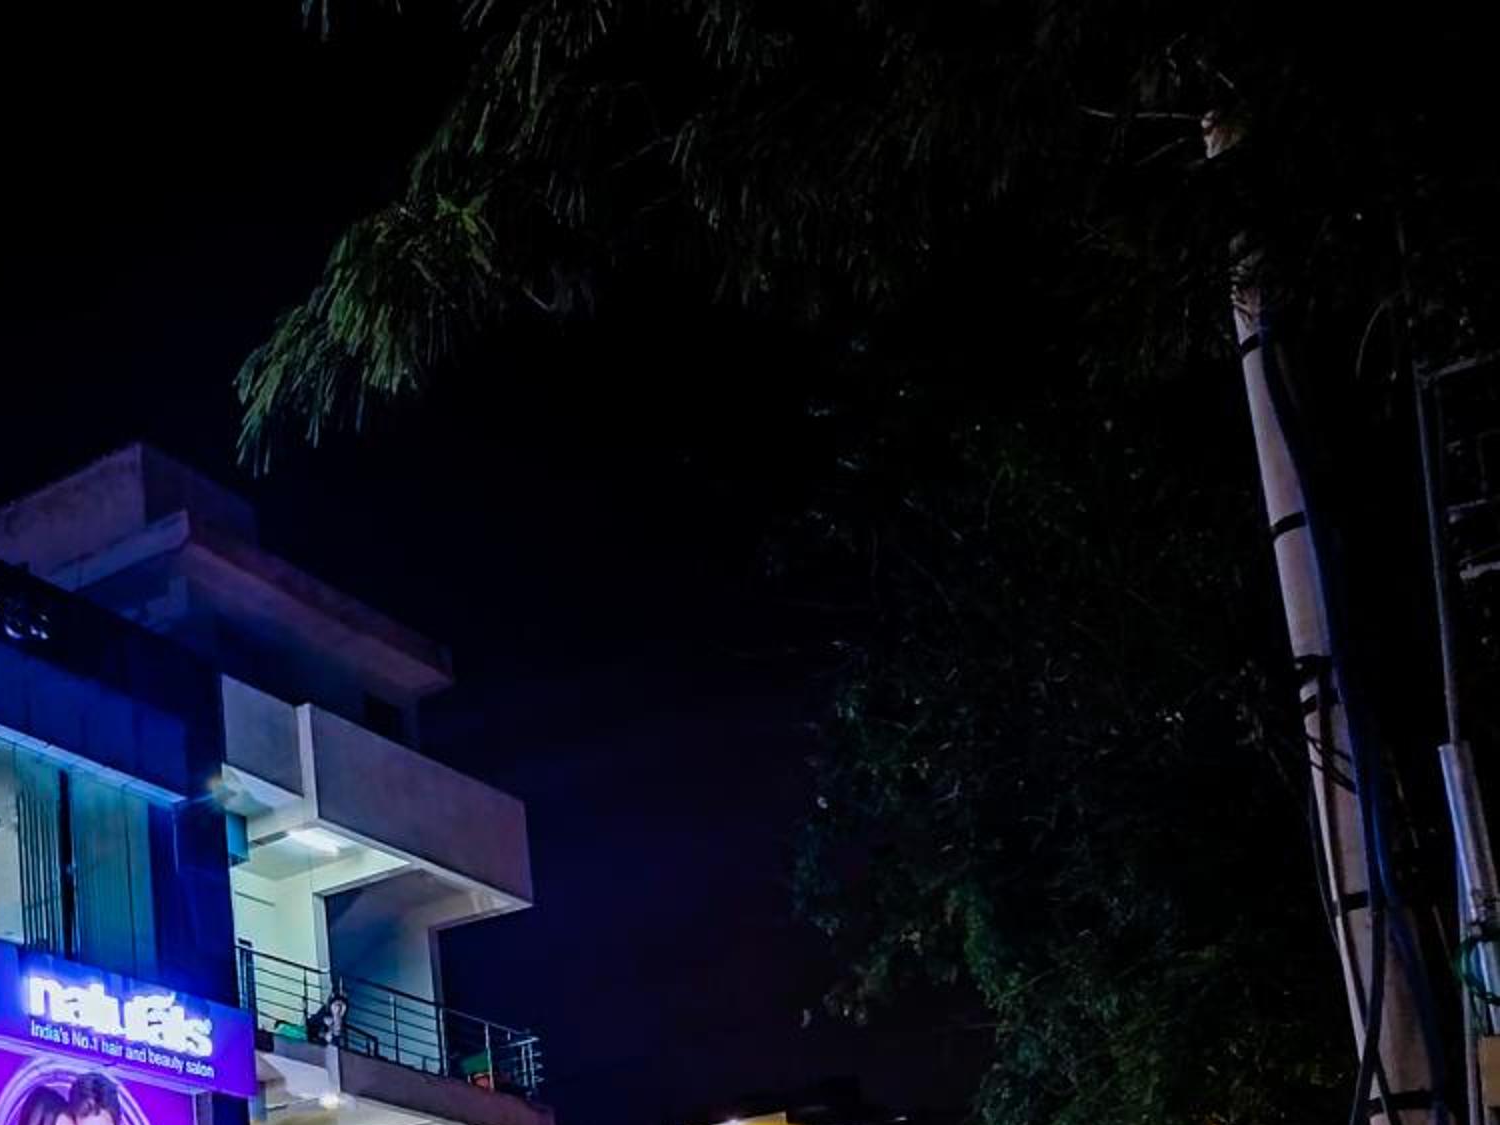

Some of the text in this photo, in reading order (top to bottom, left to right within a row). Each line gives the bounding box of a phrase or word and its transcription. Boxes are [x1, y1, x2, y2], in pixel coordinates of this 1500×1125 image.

[29, 975, 213, 1058] naturals
[31, 1019, 215, 1079] India's No.1 hair and beauty salon
